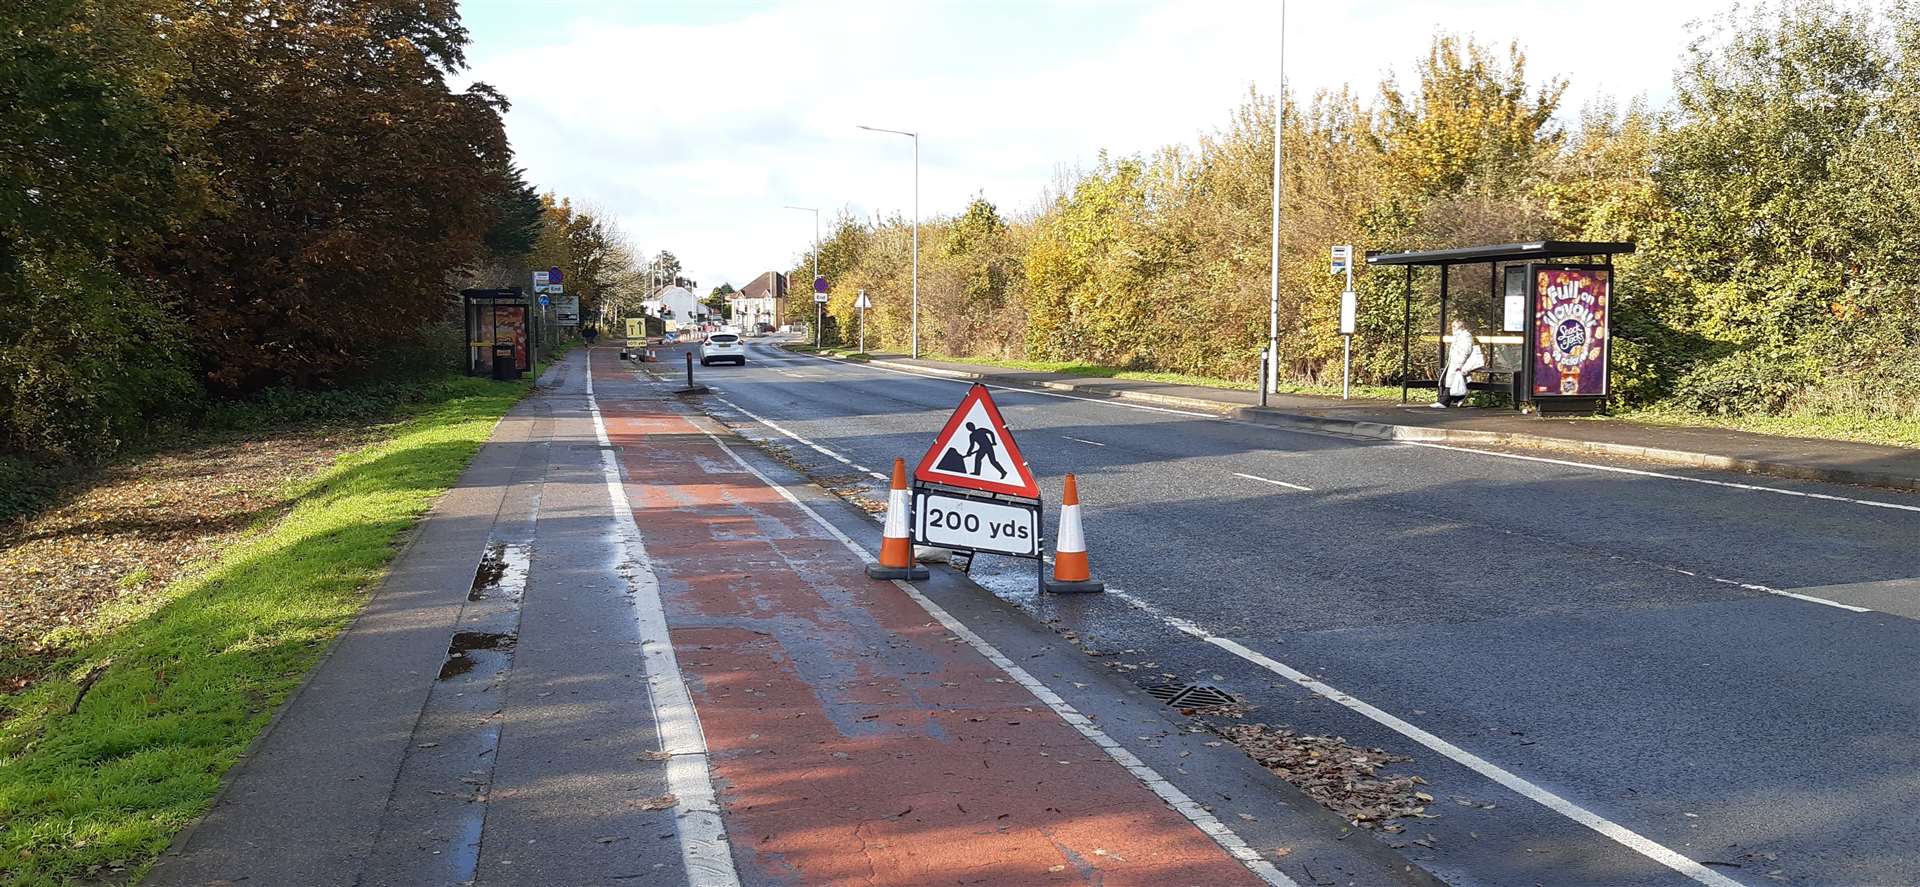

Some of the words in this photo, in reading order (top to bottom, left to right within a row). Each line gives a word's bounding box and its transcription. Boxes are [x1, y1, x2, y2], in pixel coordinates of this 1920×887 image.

[1547, 281, 1579, 304] Full
[1581, 292, 1595, 305] on
[1543, 303, 1597, 327] flavour
[929, 508, 979, 532] 200
[989, 520, 1029, 539] yds
